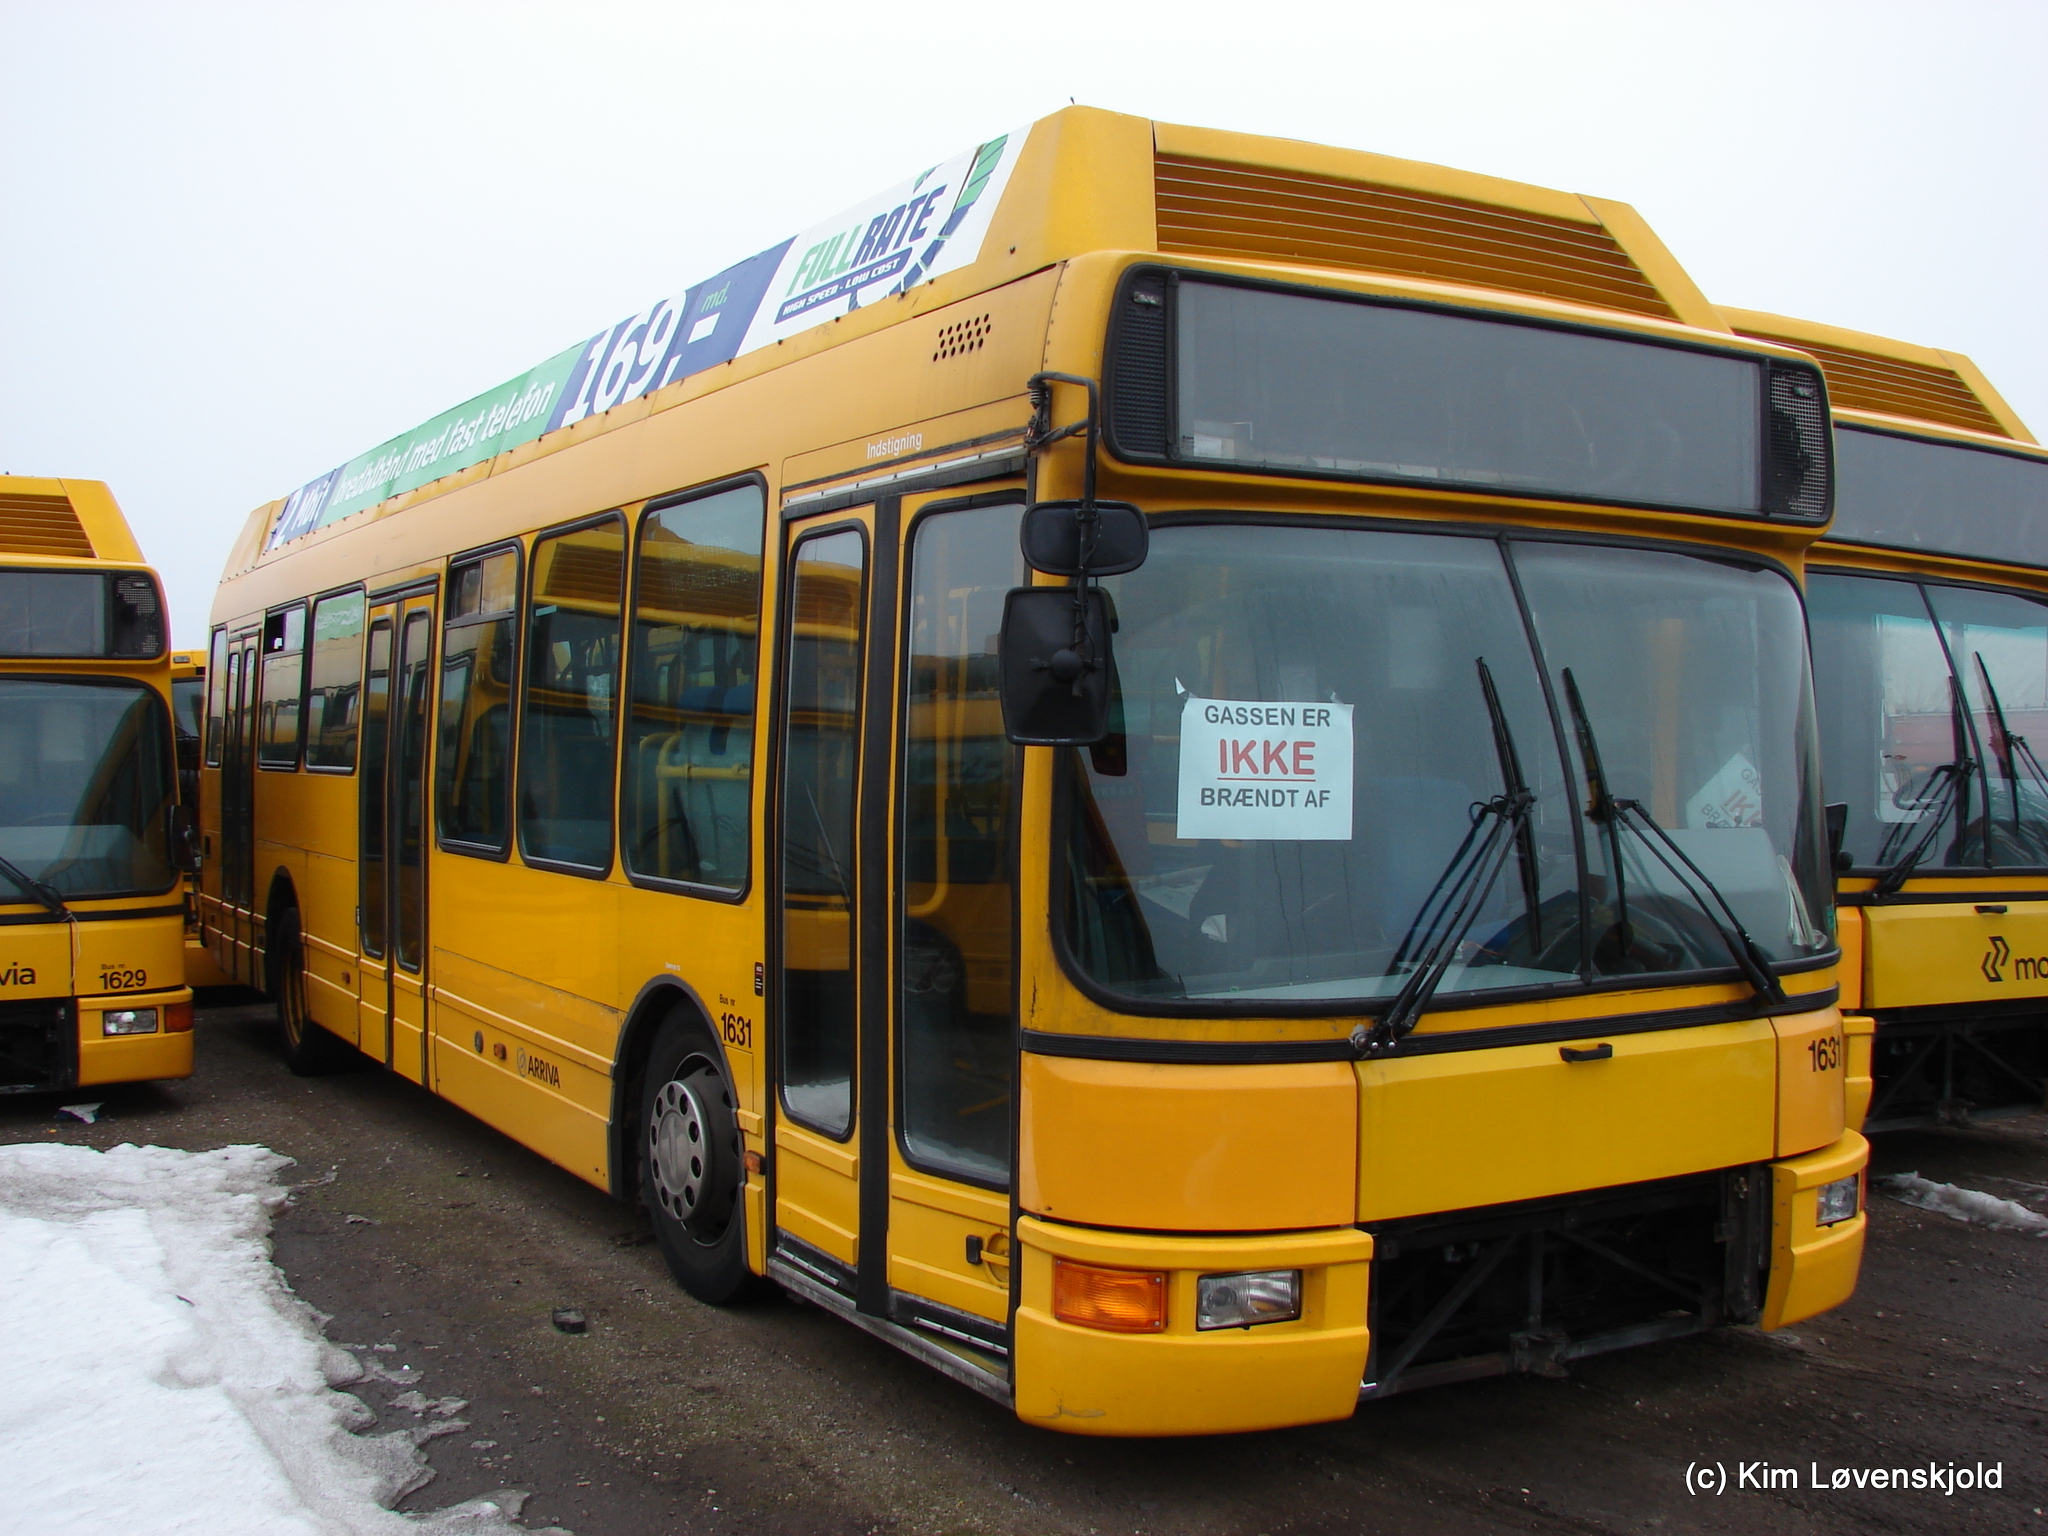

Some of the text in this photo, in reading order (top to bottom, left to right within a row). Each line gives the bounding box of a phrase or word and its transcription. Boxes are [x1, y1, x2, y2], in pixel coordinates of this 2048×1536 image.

[700, 281, 731, 313] md.
[782, 299, 805, 316] HIGH
[806, 285, 838, 306] SPEED
[845, 271, 870, 290] LOW
[871, 258, 901, 278] COST
[405, 423, 452, 474] med
[443, 410, 486, 458] fast
[480, 381, 556, 442] telefon
[867, 432, 922, 459] Indstigning
[1204, 705, 1331, 727] GASSEN ER
[1219, 738, 1316, 775] IKKE
[1200, 787, 1331, 808] BRÆNDT AF
[99, 969, 147, 990] 1629
[721, 1012, 752, 1048] 1631
[1807, 1035, 1841, 1072] 1631
[528, 1055, 561, 1089] ARRIVA
